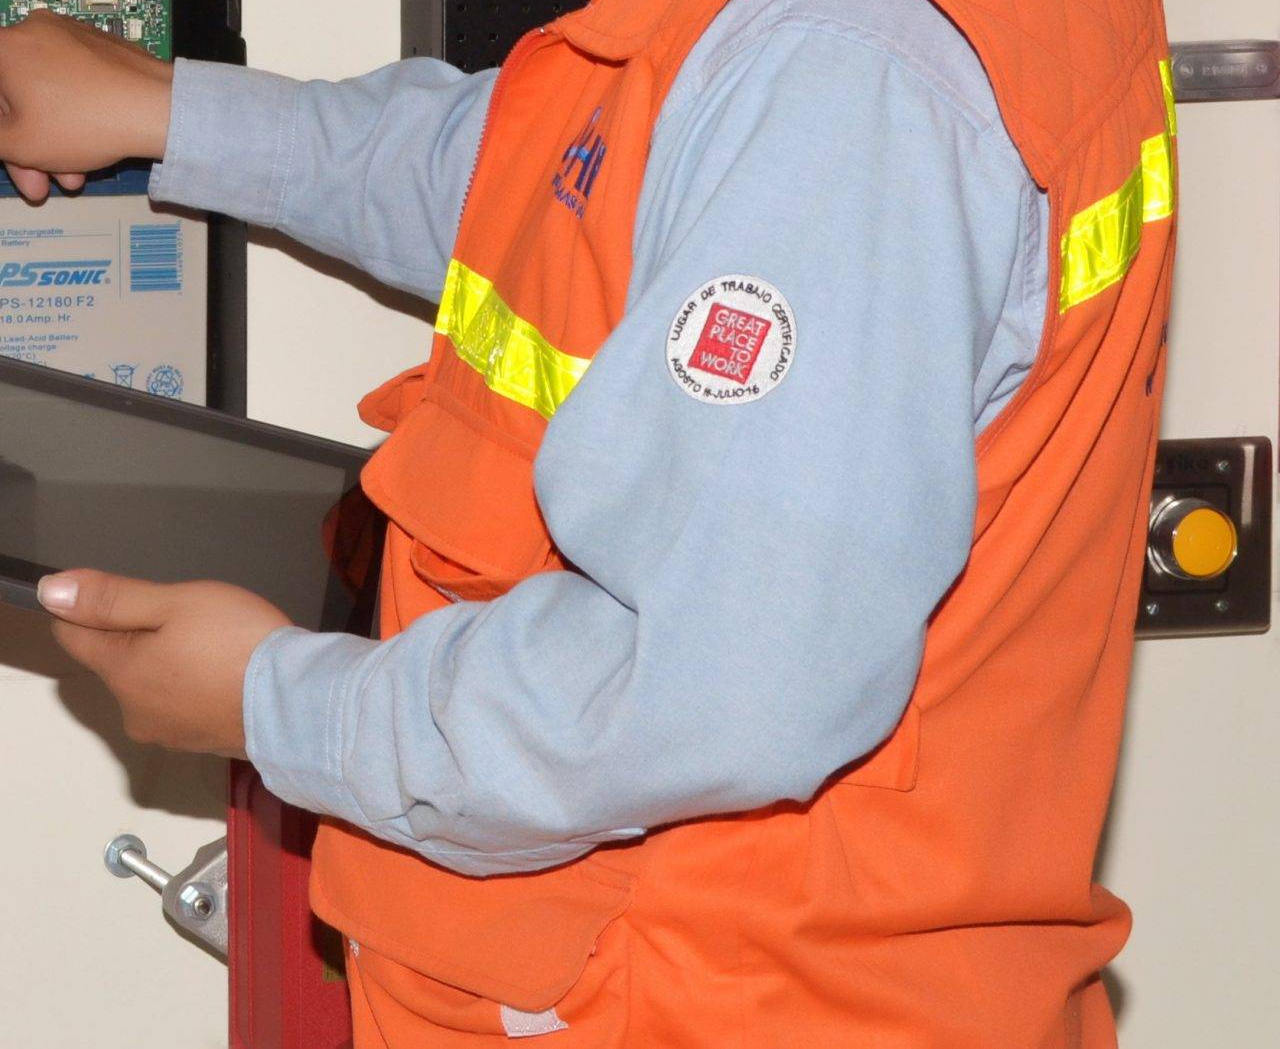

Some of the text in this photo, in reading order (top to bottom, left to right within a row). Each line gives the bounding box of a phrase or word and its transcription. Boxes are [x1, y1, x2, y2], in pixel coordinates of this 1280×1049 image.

[7, 227, 64, 239] Rechargeable
[1, 239, 30, 248] Battery
[37, 269, 104, 286] SONIC
[0, 295, 72, 310] PS-12180
[76, 295, 95, 307] F2
[0, 314, 24, 324] 18.0
[715, 309, 765, 337] GREAT
[48, 333, 79, 342] Battery
[670, 281, 793, 382] LUGAR DE TRABAJO CERTIFICADO
[709, 324, 758, 350] PLACE
[27, 343, 57, 351] charge
[730, 348, 751, 363] TO
[700, 351, 748, 379] WORK
[671, 358, 702, 393] AGOSTO
